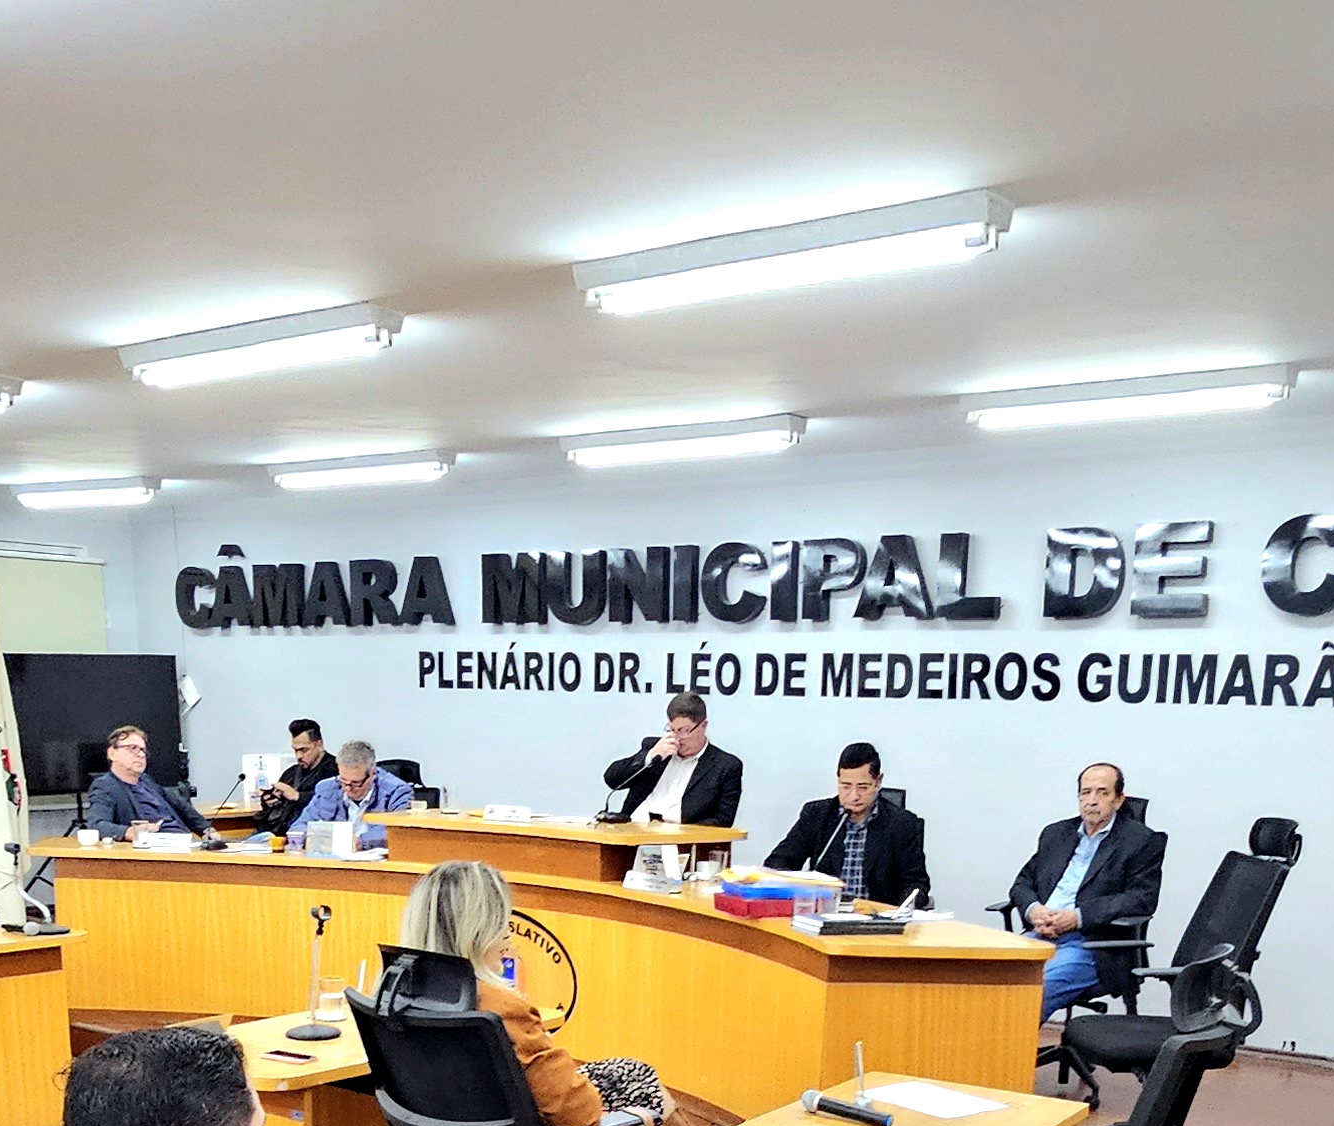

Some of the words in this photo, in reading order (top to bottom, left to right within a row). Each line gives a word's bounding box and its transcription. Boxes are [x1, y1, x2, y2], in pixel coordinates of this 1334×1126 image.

[175, 544, 455, 629] CÂMARA
[482, 532, 1001, 625] MUNICIPAL
[1043, 521, 1213, 620] DE
[418, 642, 580, 693] PLENÁRIO
[594, 651, 654, 693] DR.
[666, 642, 742, 696] LÉO
[754, 653, 807, 697] DE
[820, 651, 1062, 702] MEDEIROS
[508, 921, 562, 964] SLATIVO
